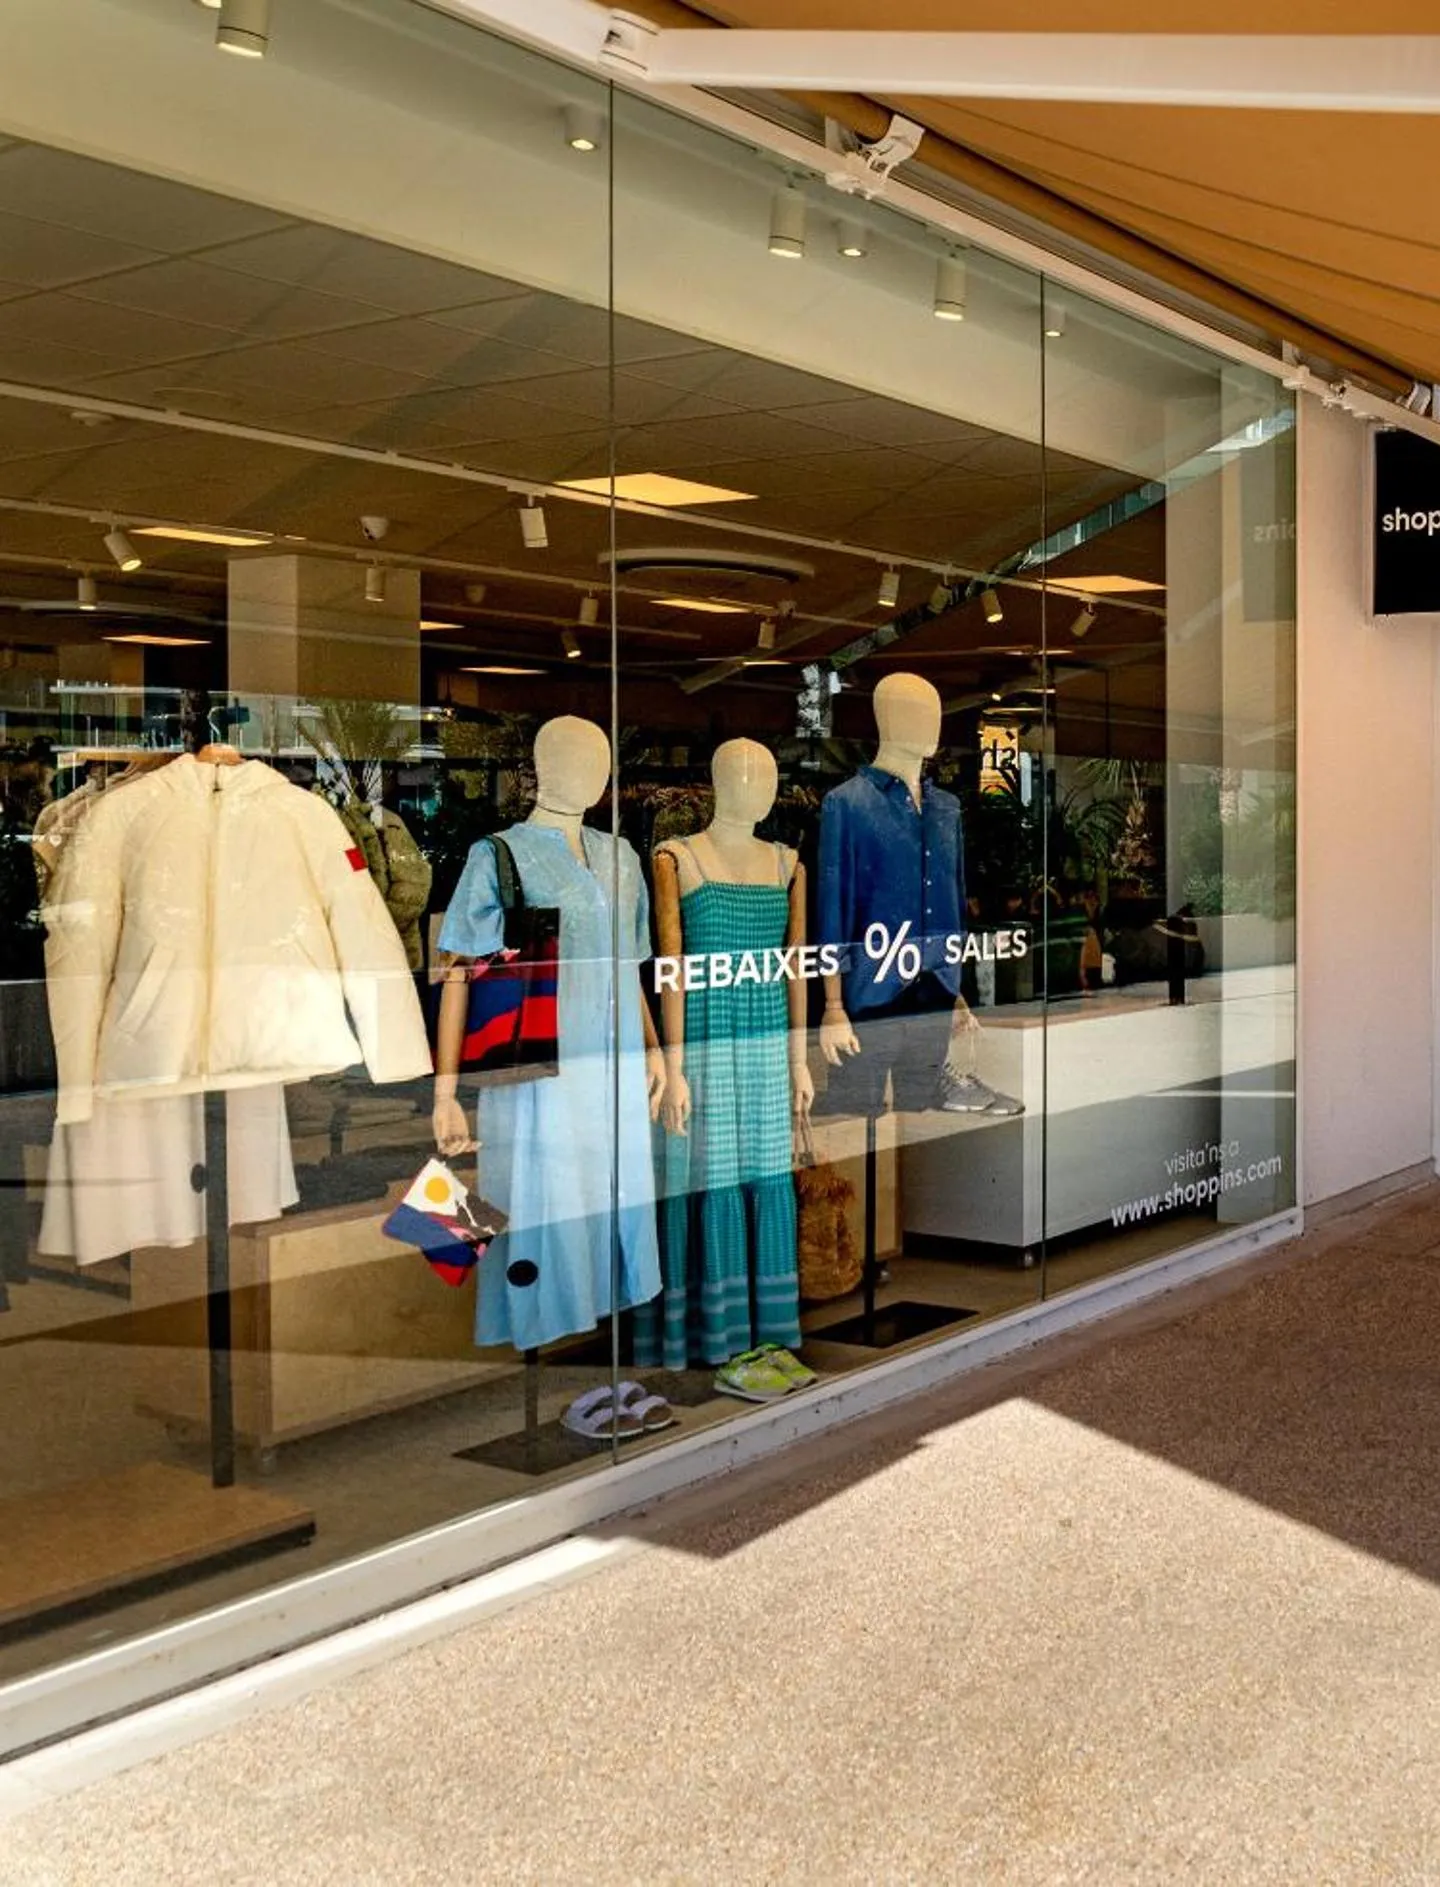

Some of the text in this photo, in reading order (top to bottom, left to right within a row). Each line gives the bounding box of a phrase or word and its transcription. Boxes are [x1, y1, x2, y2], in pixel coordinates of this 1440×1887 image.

[654, 921, 1028, 993] REBAIXES % SALES
[1110, 1154, 1281, 1227] www.shoppins.com
